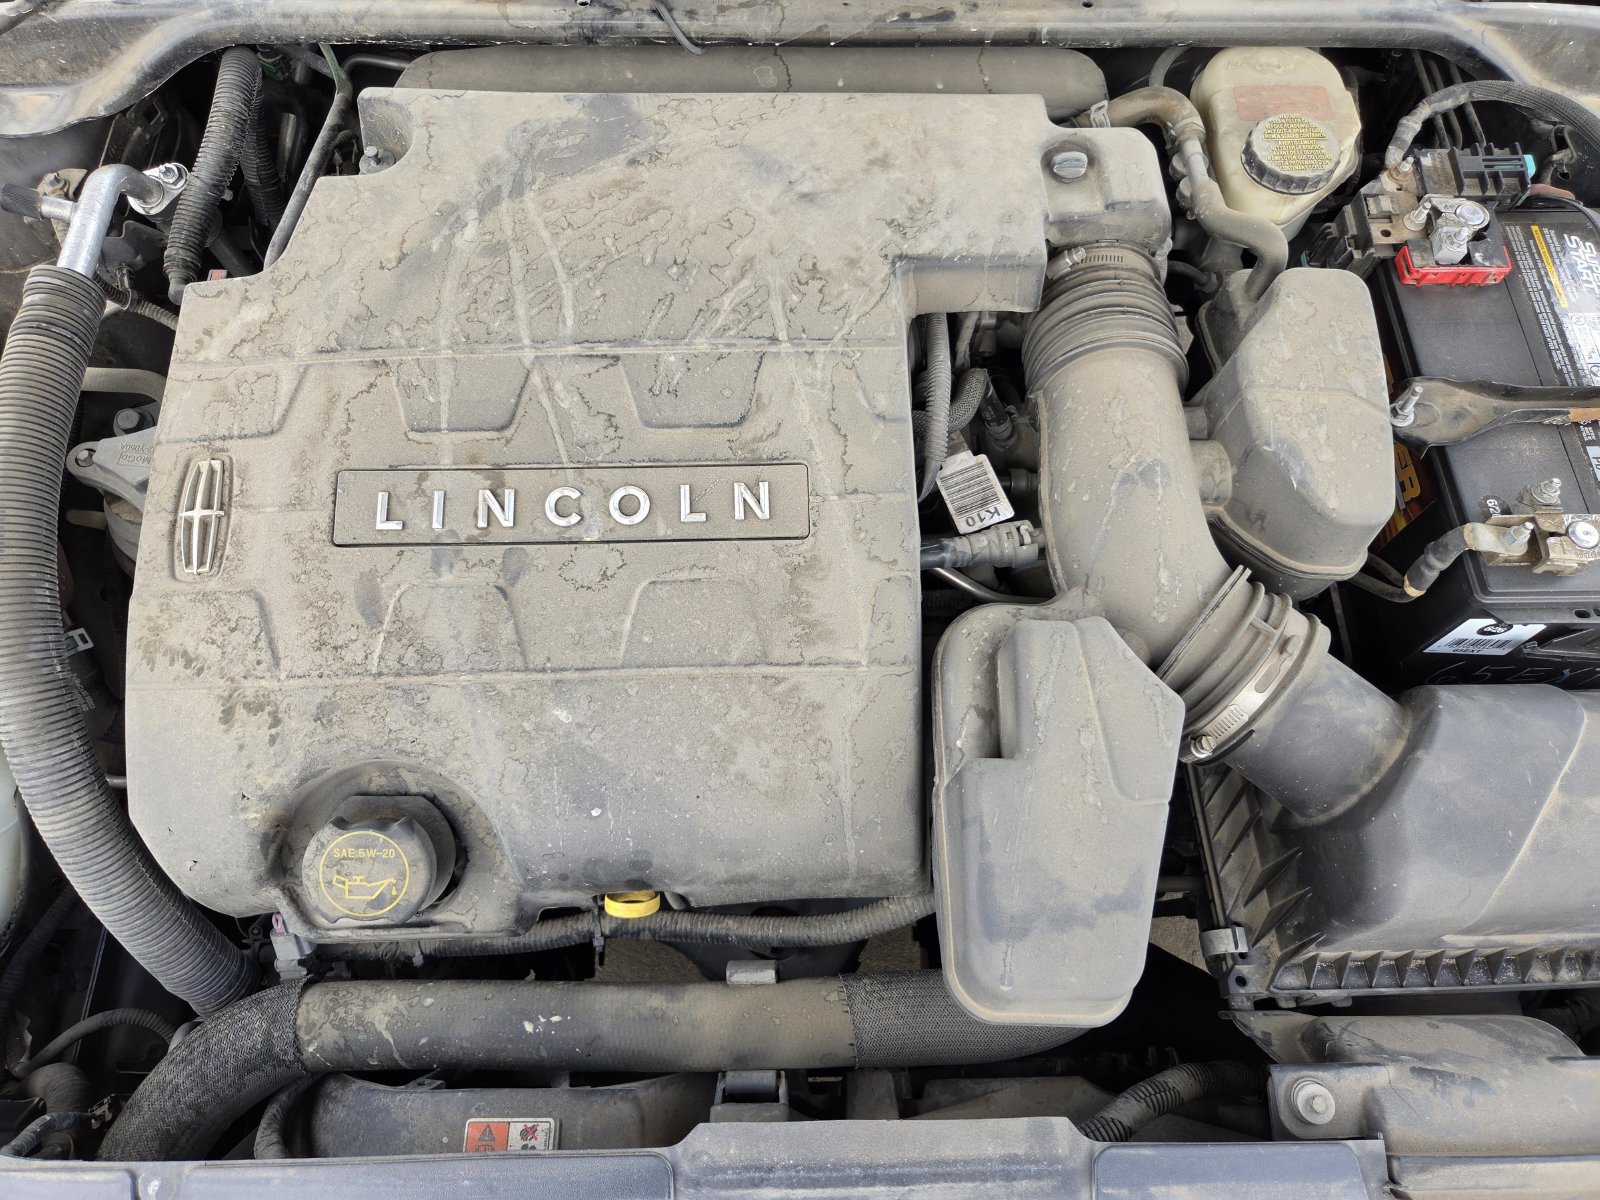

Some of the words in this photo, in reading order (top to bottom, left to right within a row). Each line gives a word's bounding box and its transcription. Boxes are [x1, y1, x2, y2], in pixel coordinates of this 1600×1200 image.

[1564, 233, 1596, 294] START
[376, 481, 770, 530] LINCOLN
[1486, 499, 1501, 516] 6/2
[965, 507, 1000, 526] K10
[334, 848, 355, 858] SAE
[358, 848, 396, 858] 5W-20
